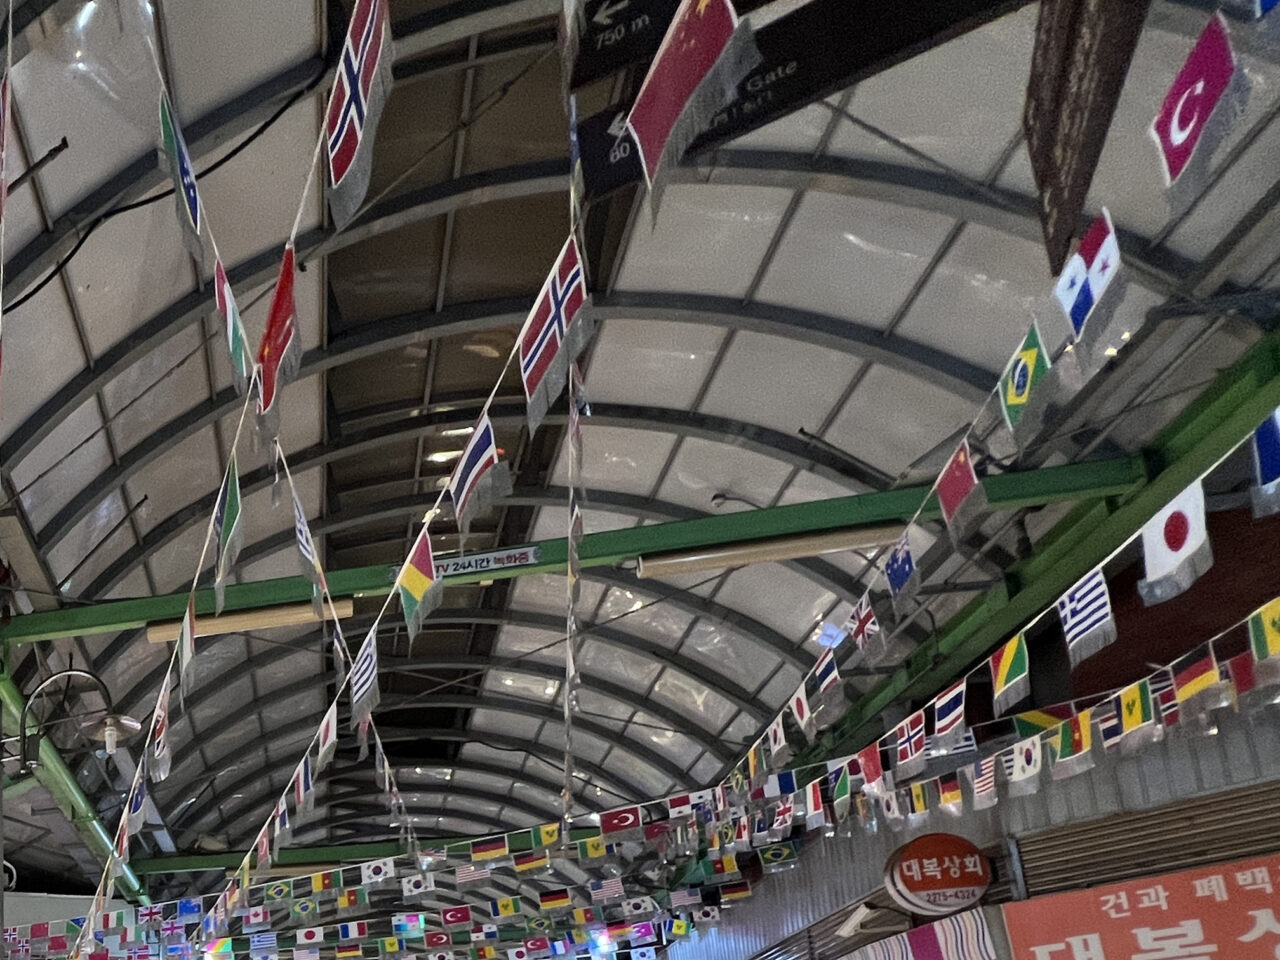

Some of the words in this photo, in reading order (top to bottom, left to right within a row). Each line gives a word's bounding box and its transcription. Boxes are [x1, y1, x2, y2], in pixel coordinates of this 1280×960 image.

[452, 557, 490, 572] 24시간
[902, 854, 983, 880] 대복상회
[1100, 885, 1169, 919] 건과
